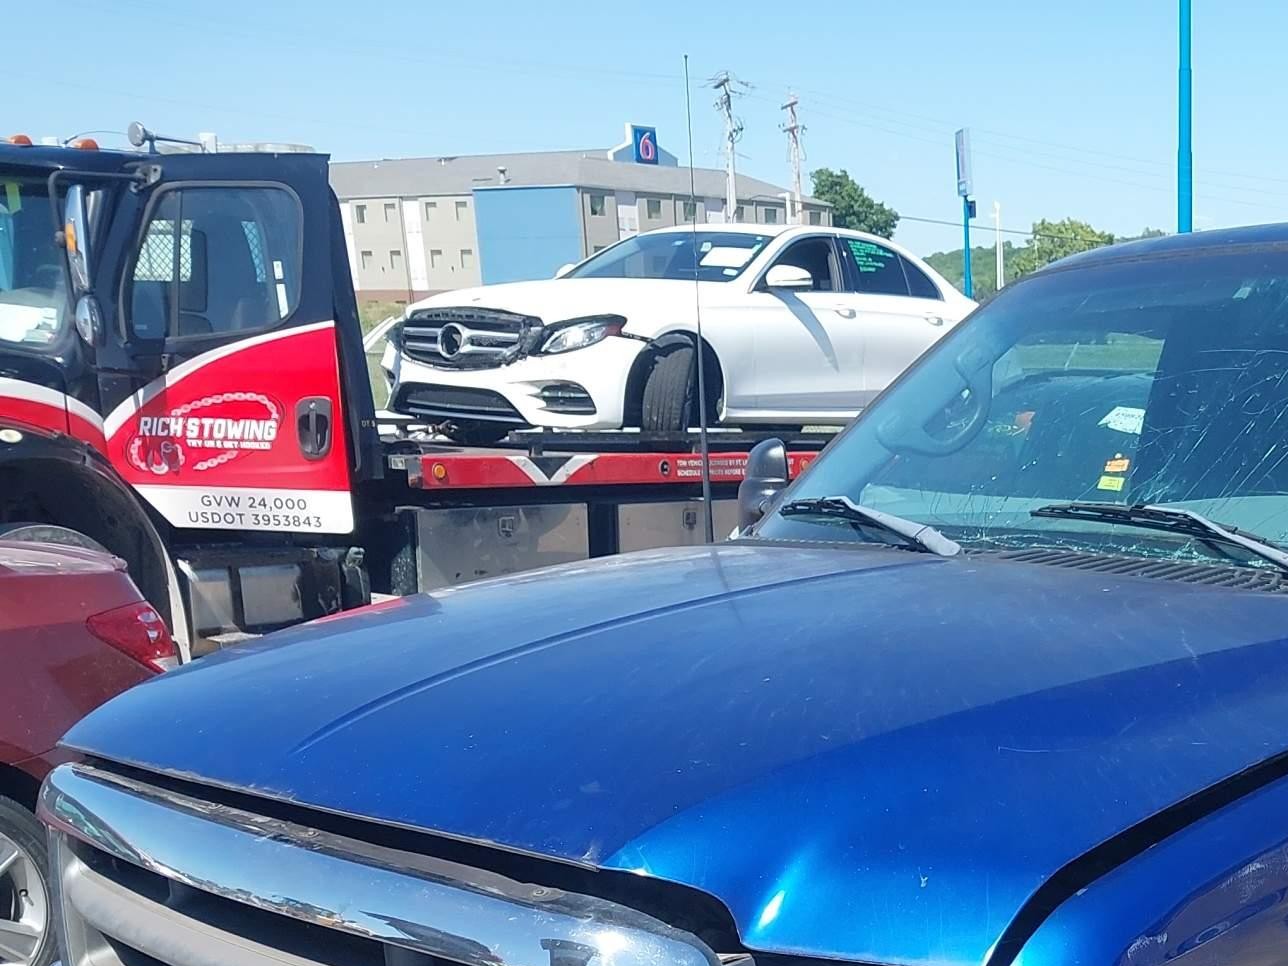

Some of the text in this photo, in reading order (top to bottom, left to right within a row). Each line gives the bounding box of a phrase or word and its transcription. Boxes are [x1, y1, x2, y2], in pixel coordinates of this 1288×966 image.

[639, 131, 655, 161] 6
[139, 416, 278, 441] RICH'S TOWING
[200, 494, 307, 511] GVW 24,000
[188, 511, 322, 528] USDOT 3953843
